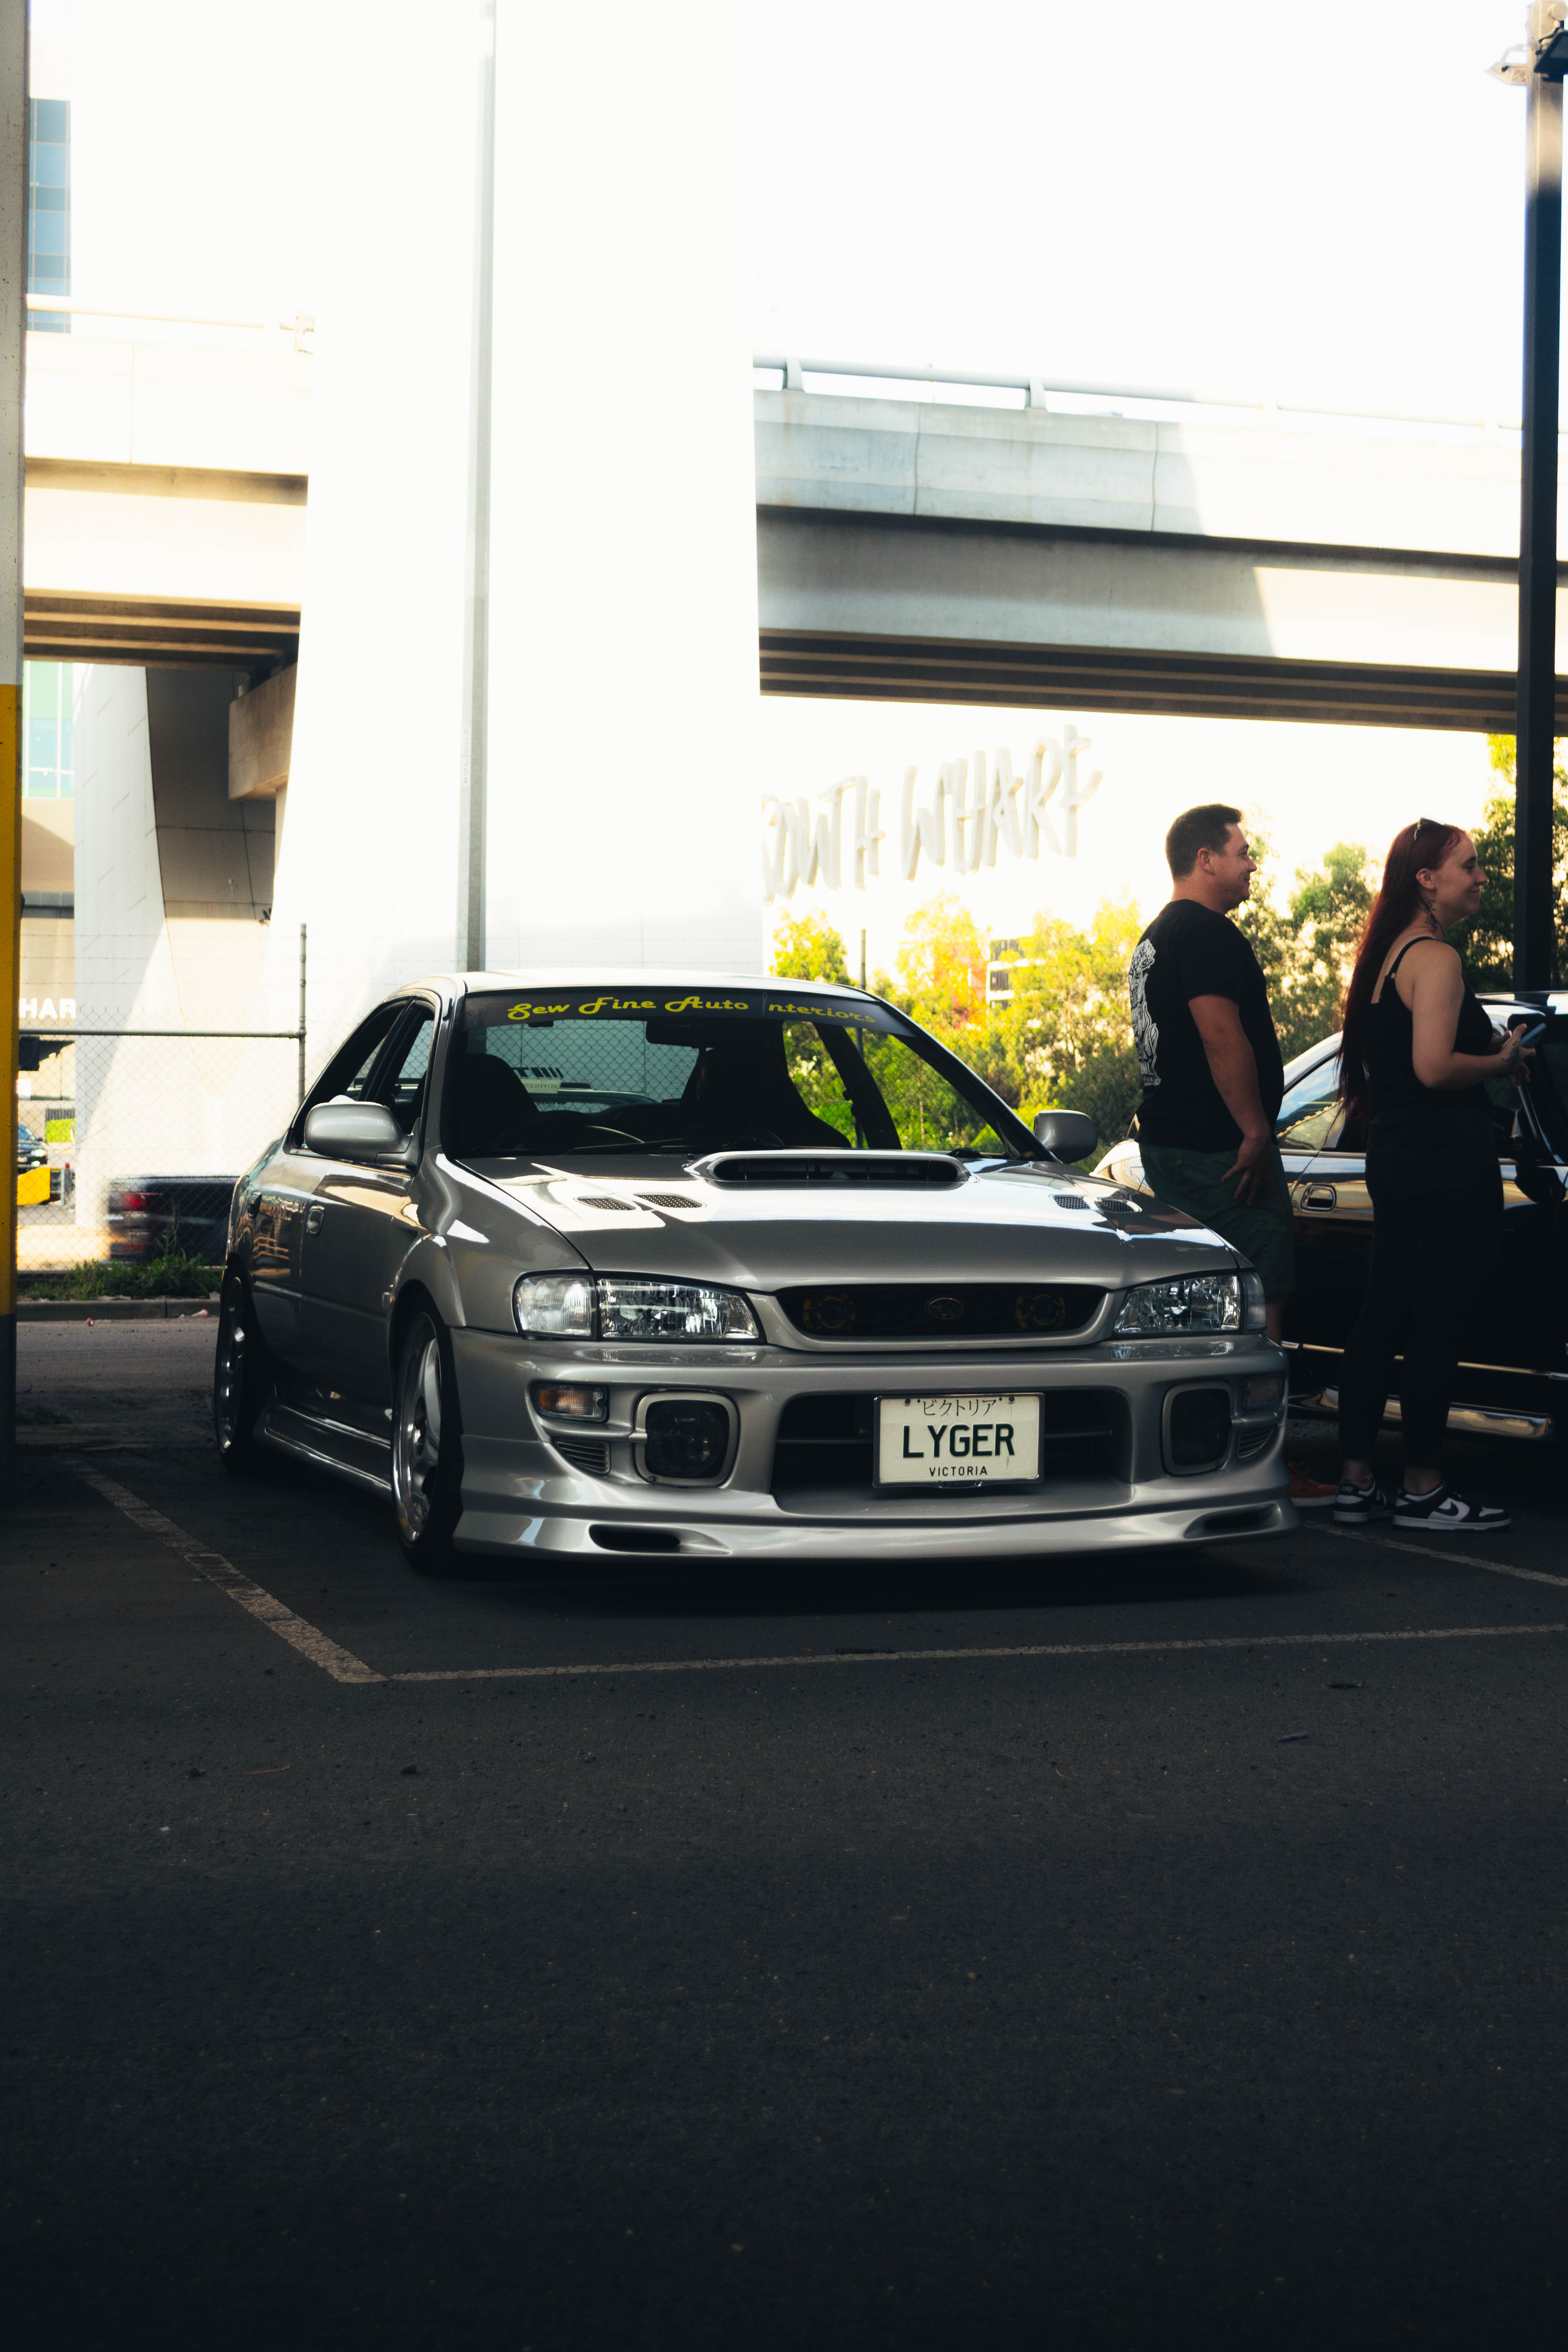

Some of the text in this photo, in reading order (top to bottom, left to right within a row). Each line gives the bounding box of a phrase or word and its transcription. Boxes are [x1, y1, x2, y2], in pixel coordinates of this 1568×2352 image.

[901, 723, 1103, 881] WHARF
[508, 1003, 570, 1020] Sew
[579, 997, 656, 1015] Fine
[664, 996, 748, 1012] Auto
[923, 1399, 996, 1416] ビクトリア
[929, 1466, 987, 1477] VICTORIA
